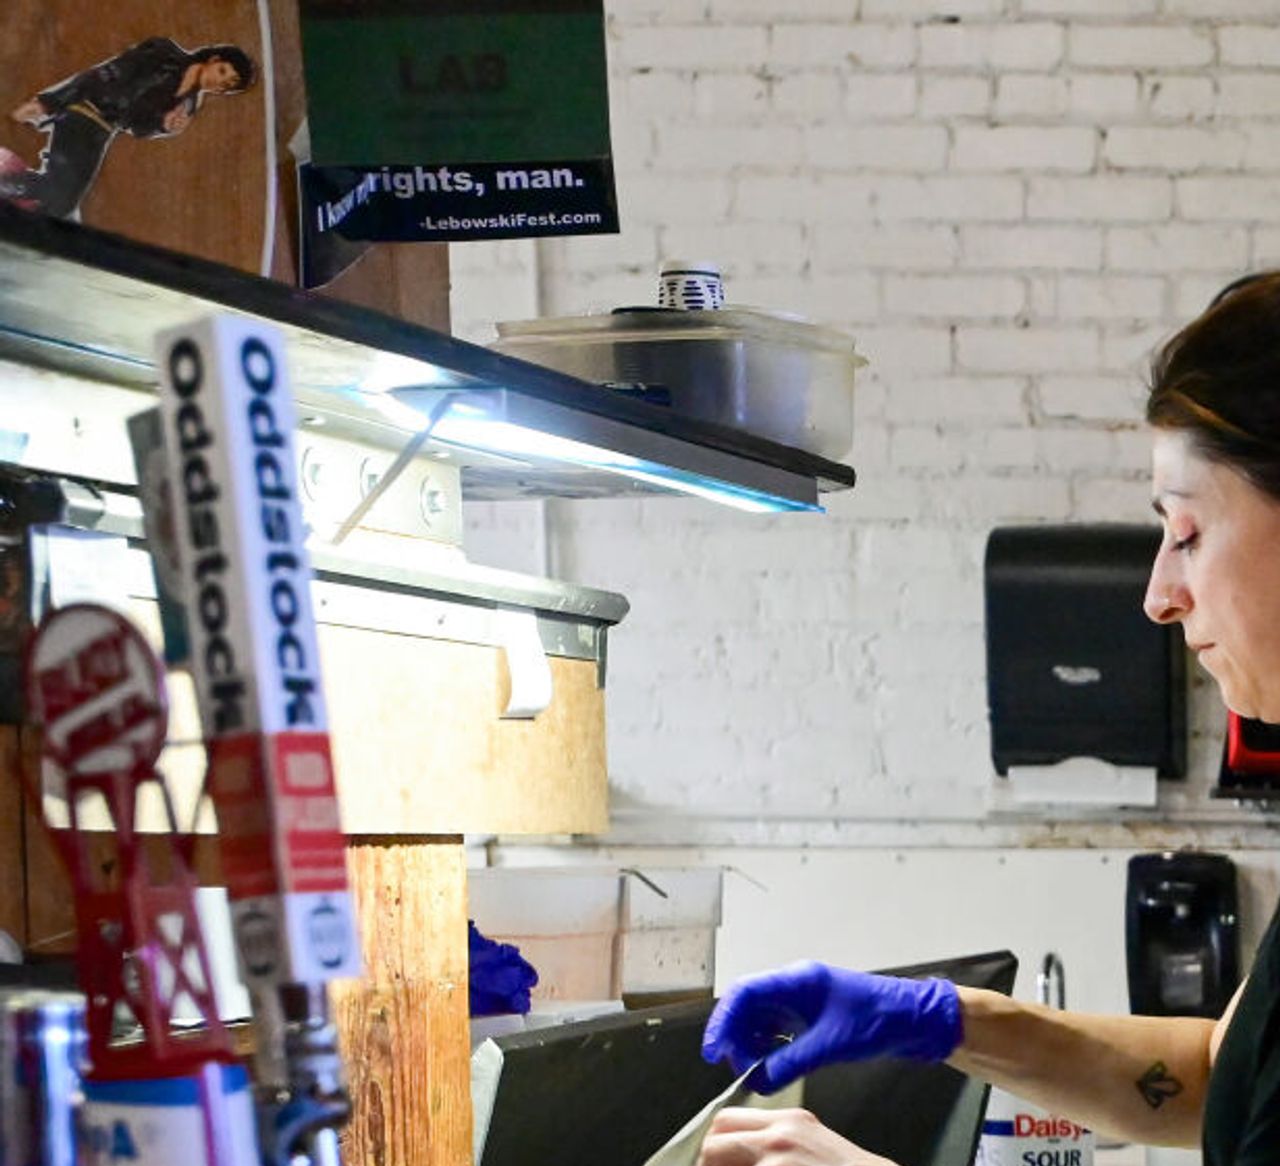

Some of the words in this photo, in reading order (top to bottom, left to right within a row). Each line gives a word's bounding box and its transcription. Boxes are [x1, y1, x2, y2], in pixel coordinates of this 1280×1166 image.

[369, 166, 486, 199] rights,
[496, 167, 585, 190] man.
[420, 211, 602, 231] -LebowskiFest.com
[166, 336, 248, 735] Oddstock
[239, 335, 316, 728] Oddstock
[1014, 1113, 1082, 1141] Daisy
